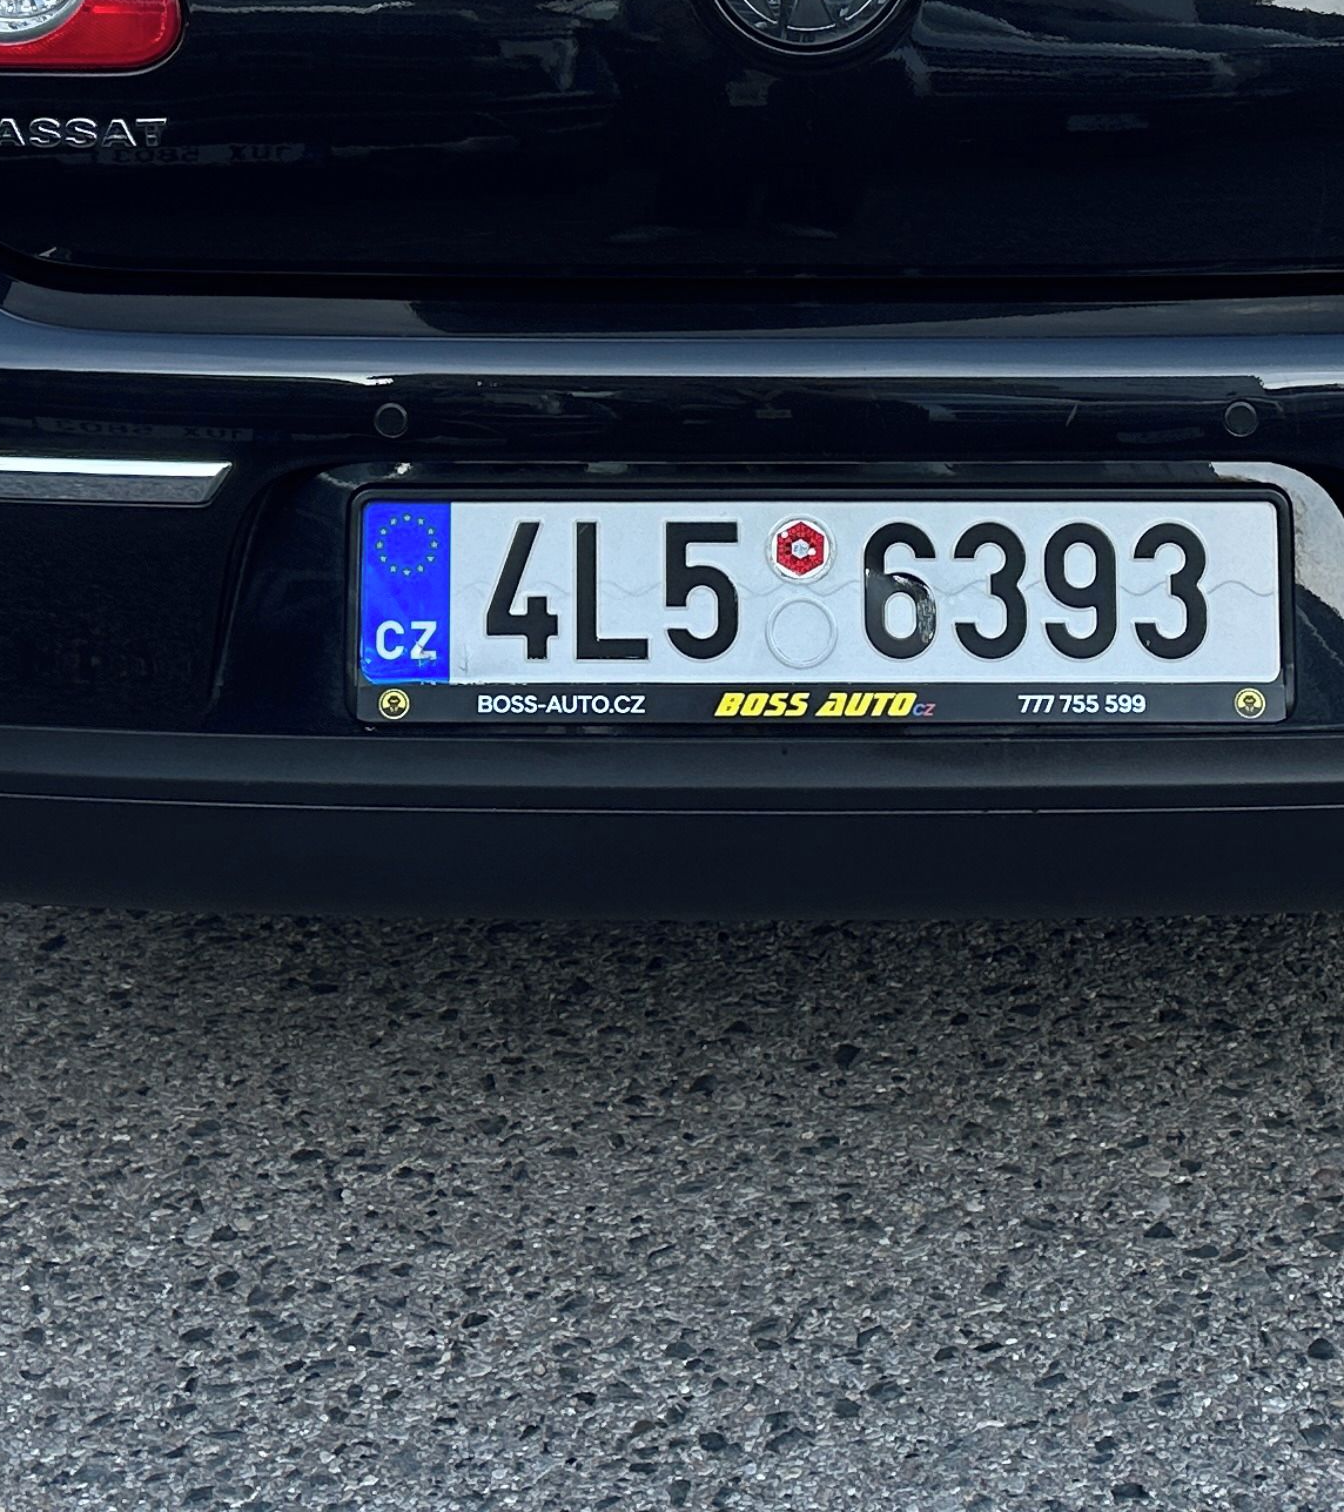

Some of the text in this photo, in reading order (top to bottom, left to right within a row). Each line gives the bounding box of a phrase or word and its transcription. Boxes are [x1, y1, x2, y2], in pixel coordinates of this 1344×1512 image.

[486, 521, 1208, 660] 4L5 6393
[375, 620, 437, 660] CZ
[477, 694, 646, 714] BOSS-AUTO.CZ
[714, 692, 810, 717] BOSS
[1018, 694, 1146, 714] 777 755 599
